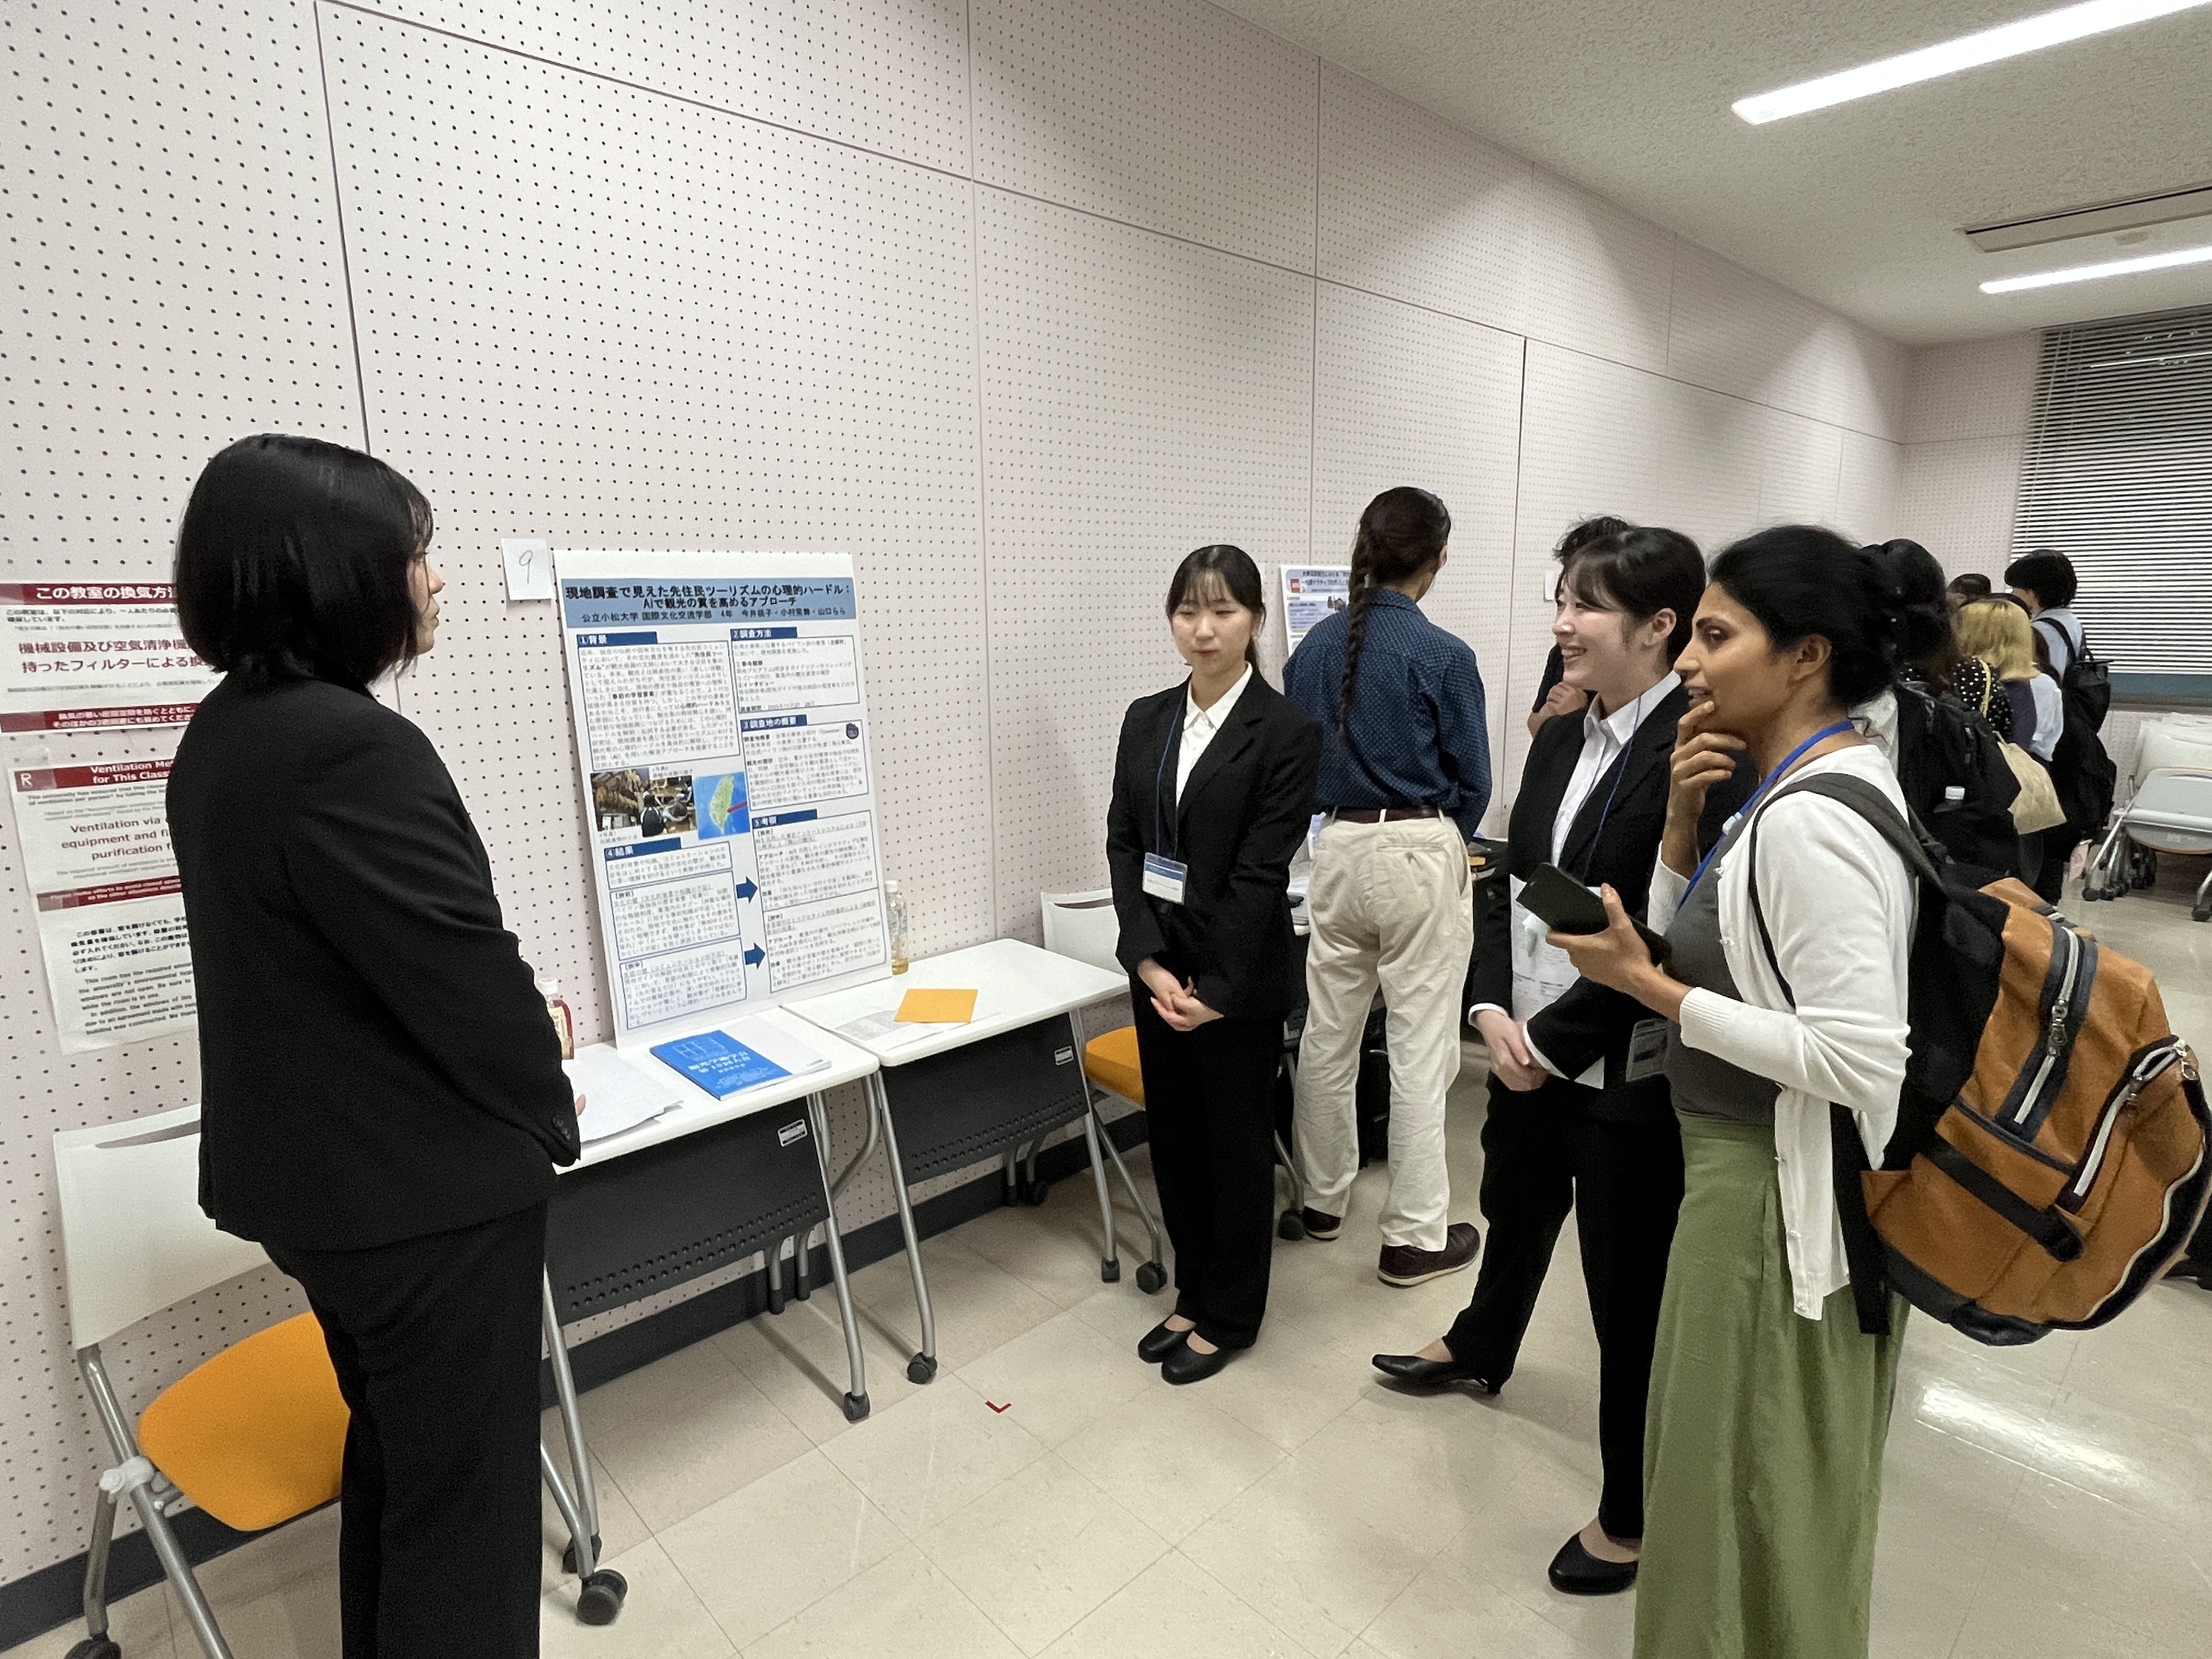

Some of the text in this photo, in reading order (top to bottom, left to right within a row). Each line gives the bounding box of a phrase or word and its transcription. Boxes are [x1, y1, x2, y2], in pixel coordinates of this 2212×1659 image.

[519, 550, 533, 584] 9
[90, 762, 152, 774] Ventilation
[20, 773, 33, 787] R
[112, 772, 137, 781] This
[70, 816, 160, 833] Ventilation via
[61, 834, 129, 850] equipment
[134, 830, 157, 840] and
[92, 845, 162, 861] purification
